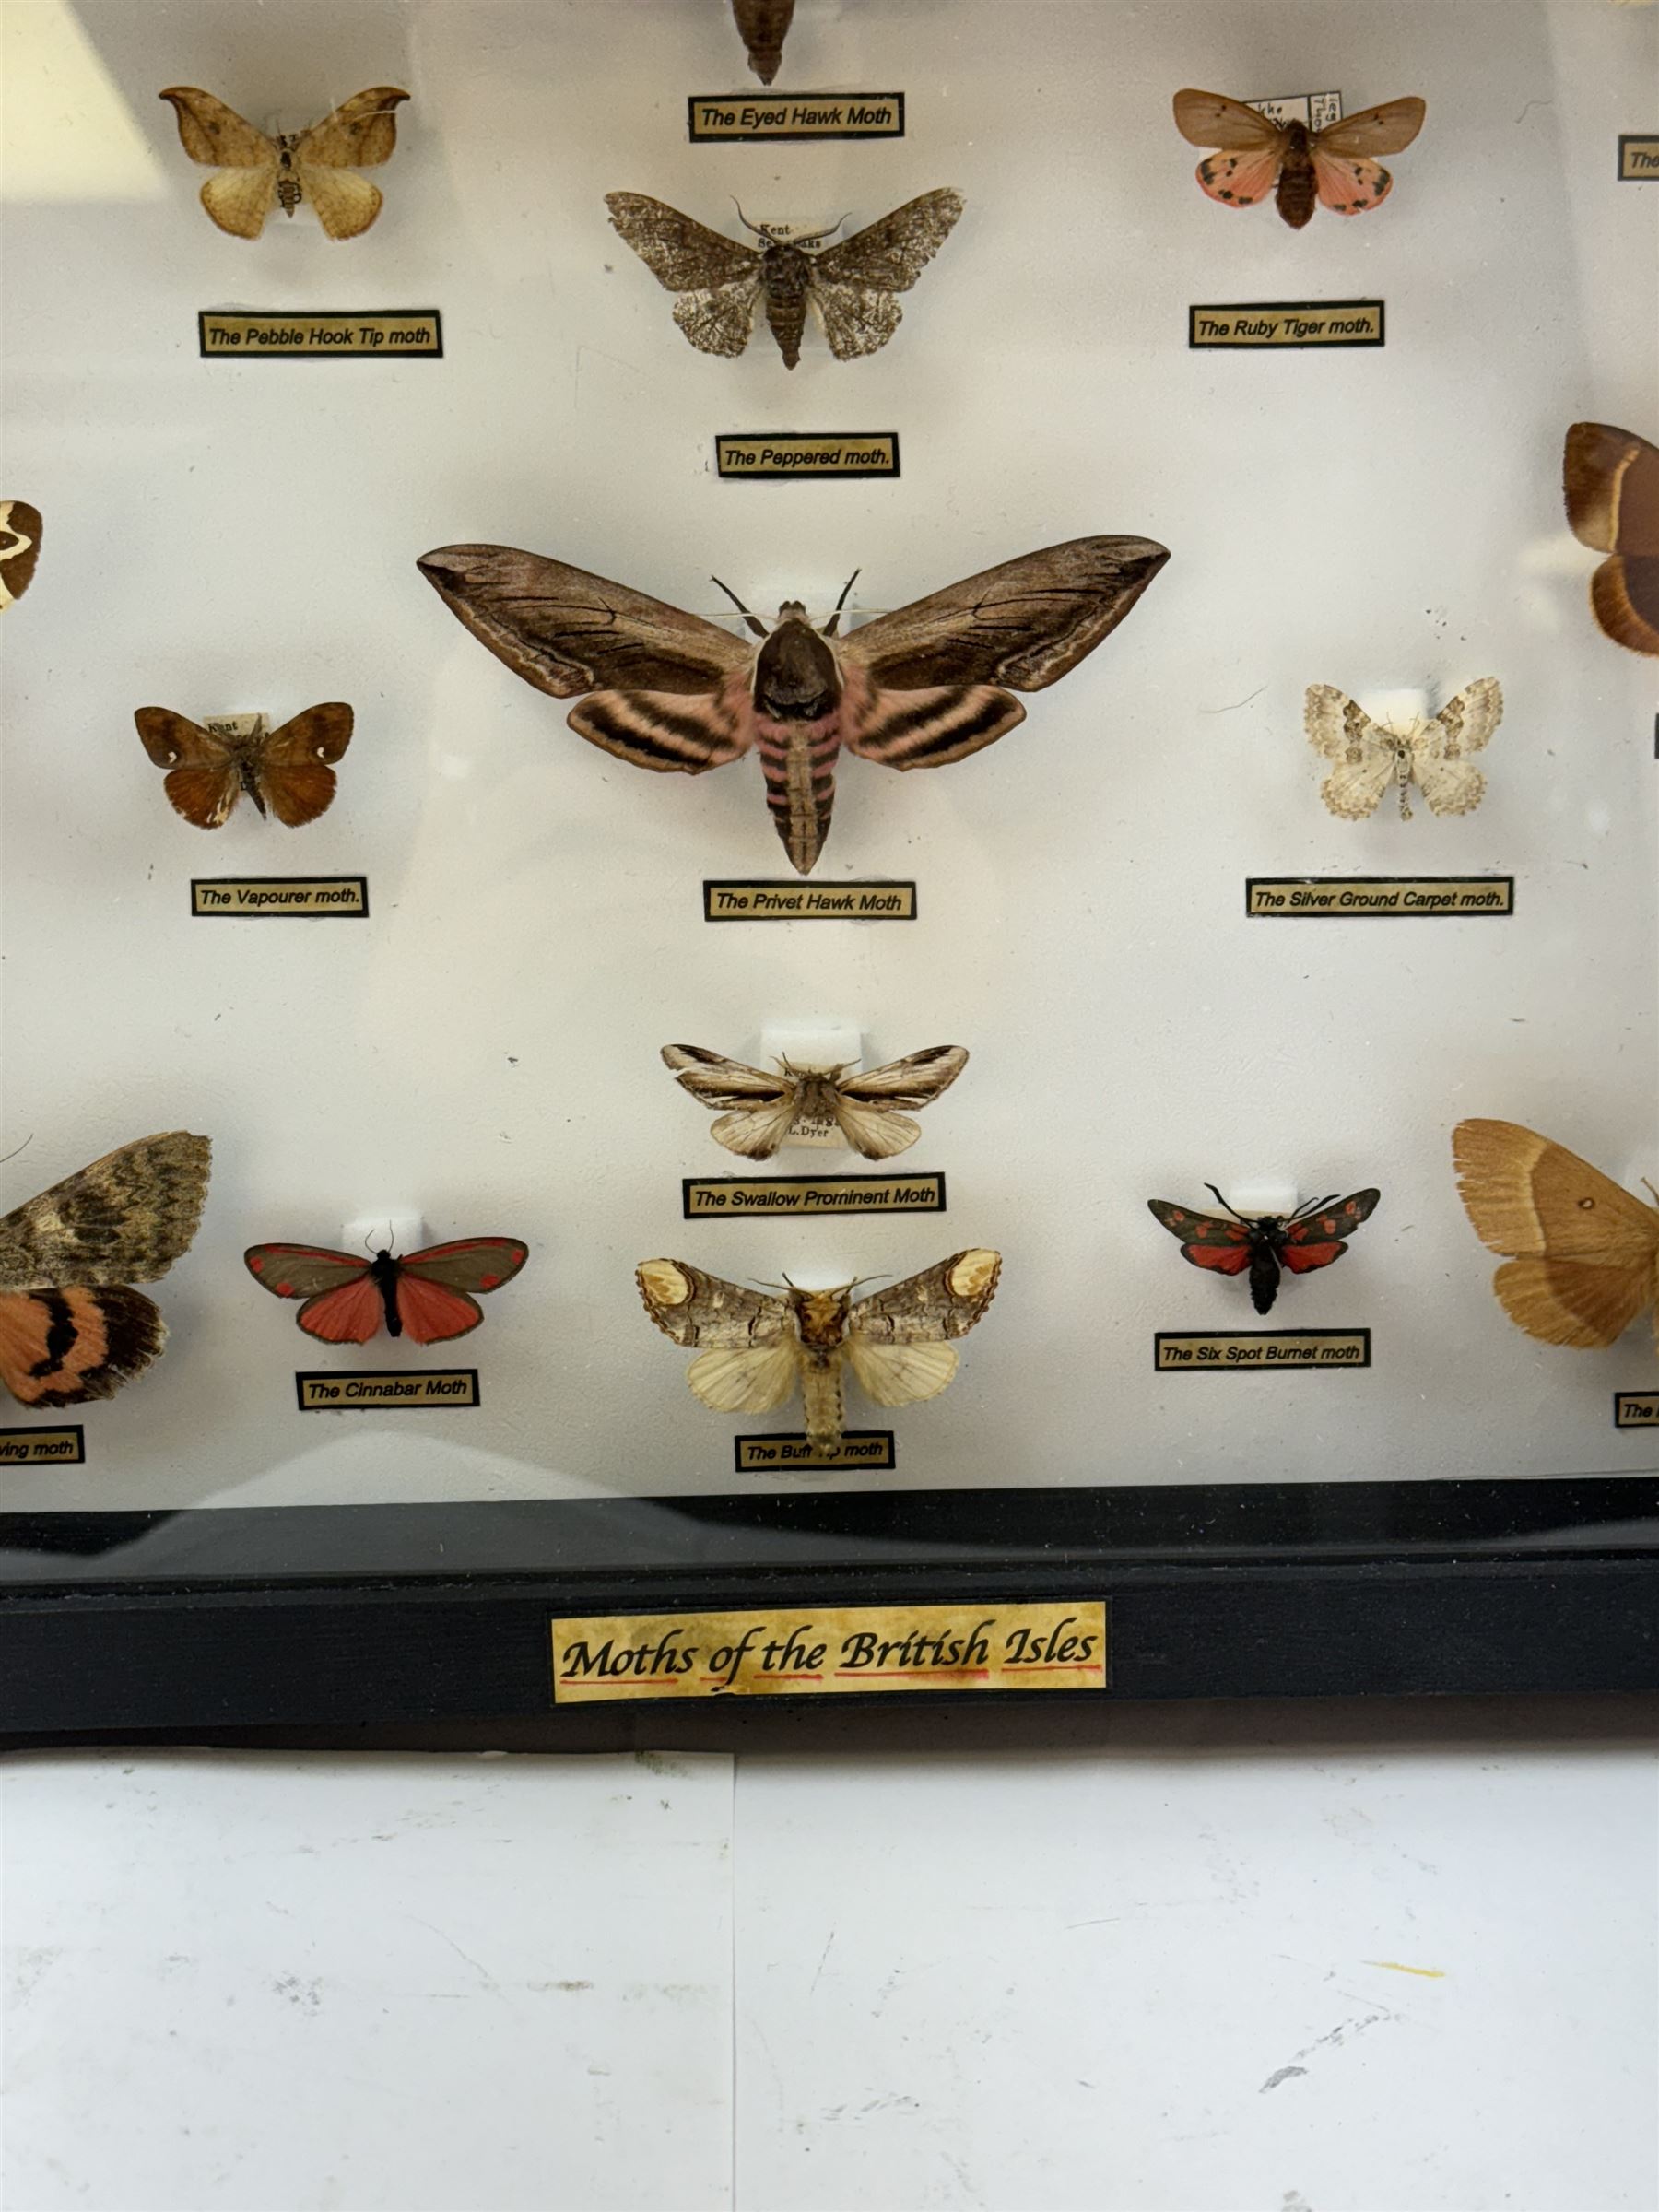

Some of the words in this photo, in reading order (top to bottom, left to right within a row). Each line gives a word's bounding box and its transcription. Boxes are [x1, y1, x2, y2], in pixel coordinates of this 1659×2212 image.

[702, 109, 735, 125] The
[740, 108, 787, 129] Eyed
[792, 108, 842, 124] Hawk
[847, 107, 892, 124] Moth
[209, 328, 241, 345] The
[246, 328, 304, 345] Pebble
[309, 328, 354, 345] Hook
[359, 327, 384, 347] Tip
[388, 327, 430, 344] moth
[1199, 320, 1230, 336] The
[1234, 320, 1279, 339] Ruby
[1284, 319, 1325, 338] Tiger
[1328, 317, 1373, 334] moth.
[725, 450, 756, 465] The
[760, 449, 841, 467] Peppered
[844, 448, 889, 465] moth.
[201, 890, 231, 904] The
[237, 889, 312, 907] Vapourer
[315, 888, 359, 903] moth.
[716, 893, 748, 909] The
[752, 893, 804, 909] Privet
[806, 894, 856, 910] Hawk
[858, 894, 902, 911] Moth
[1255, 892, 1285, 906] The
[1289, 891, 1336, 906] Silver
[1339, 891, 1399, 906] Ground
[1403, 891, 1457, 909] Carpet
[1460, 890, 1504, 906] moth.
[696, 1191, 725, 1206] The
[731, 1190, 800, 1206] Swallow
[804, 1189, 888, 1206] Prominent
[892, 1187, 935, 1203] Moth
[1163, 1347, 1193, 1360] The
[1196, 1347, 1220, 1360] Six
[1226, 1346, 1263, 1362] Spot
[1265, 1346, 1318, 1359] Burnet
[1321, 1345, 1359, 1359] moth
[309, 1384, 339, 1398] The
[346, 1382, 421, 1397] Cinnabar
[425, 1380, 467, 1394] Moth
[1624, 1404, 1653, 1418] The
[33, 1441, 73, 1455] moth
[747, 1446, 777, 1460] The
[844, 1443, 883, 1456] moth
[561, 1629, 699, 1677] Moths
[709, 1626, 767, 1694] of
[762, 1625, 828, 1670] the
[841, 1619, 997, 1668] British
[1006, 1617, 1099, 1665] Isles
